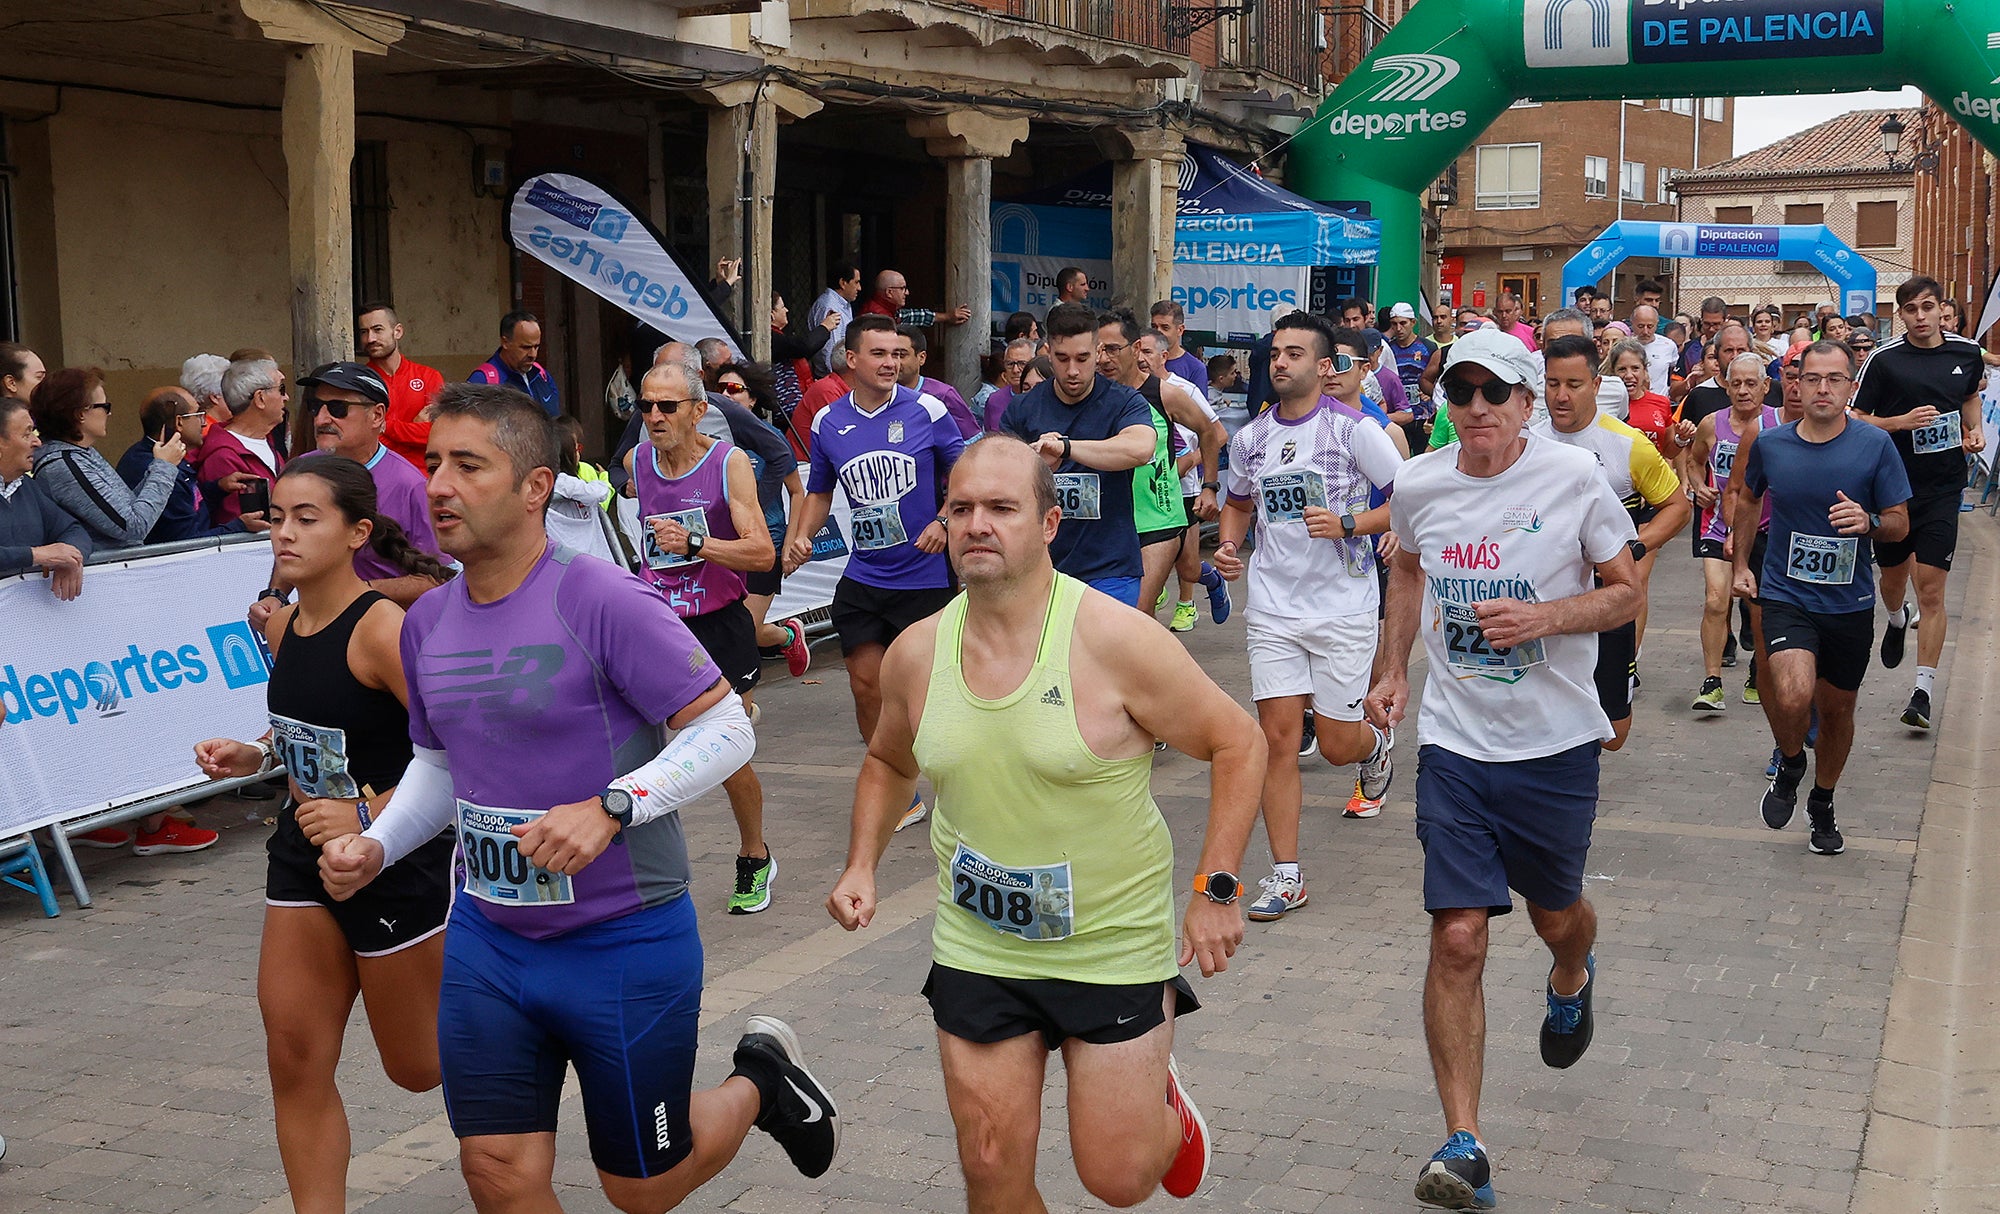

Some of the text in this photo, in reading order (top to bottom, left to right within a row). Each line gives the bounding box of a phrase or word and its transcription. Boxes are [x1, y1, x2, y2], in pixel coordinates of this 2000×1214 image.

[1643, 10, 1876, 47] DE PALENCIA
[1330, 108, 1467, 140] deportes
[1176, 216, 1254, 232] tación
[1700, 229, 1763, 241] Diputación
[1174, 242, 1285, 263] ALENCIA
[1587, 245, 1624, 277] deportes
[1700, 243, 1777, 253] DE PALENCIA
[1815, 249, 1853, 280] deportes
[1171, 283, 1296, 314] eportes
[1916, 425, 1949, 445] 334
[1265, 486, 1308, 513] 339
[853, 519, 886, 541] 291
[813, 537, 845, 555] ALENCIA
[1441, 536, 1501, 570] #MÁS
[1791, 547, 1838, 574] 230
[0, 643, 208, 725] deportes
[464, 831, 528, 885] 300
[974, 861, 1009, 880] 10.000
[956, 873, 1033, 927] 208
